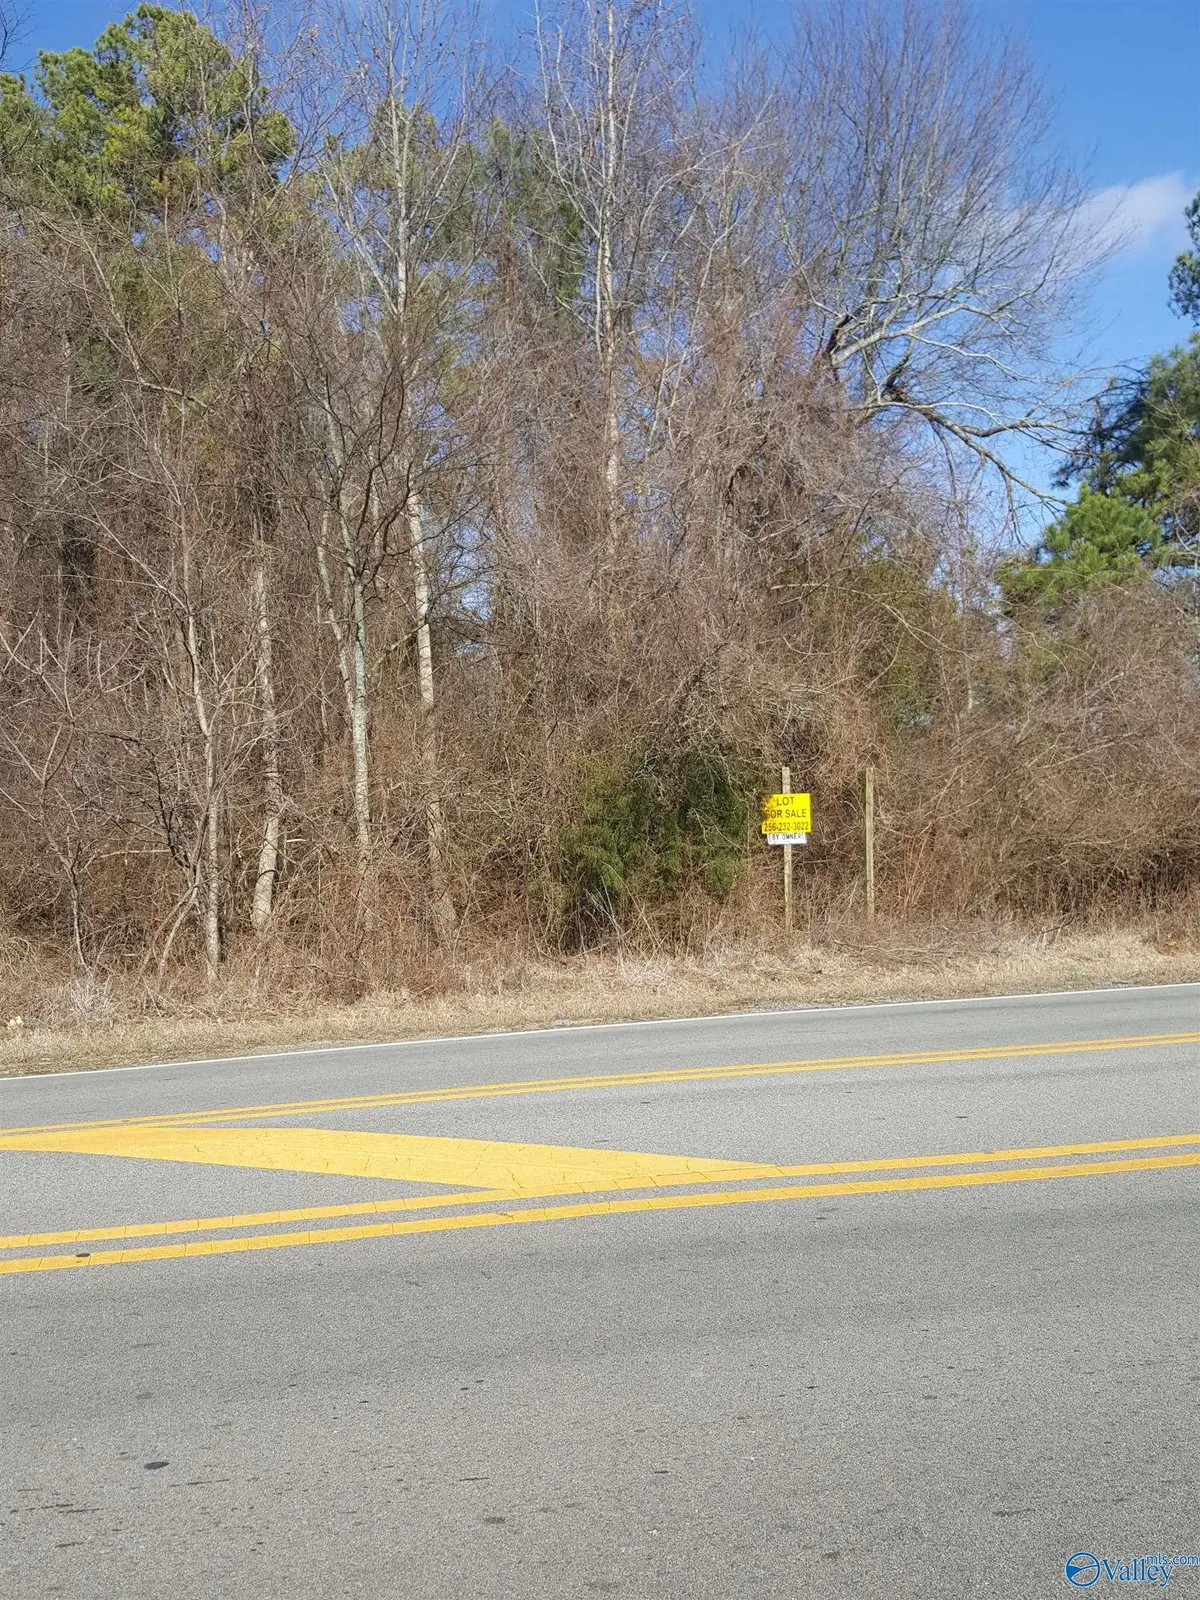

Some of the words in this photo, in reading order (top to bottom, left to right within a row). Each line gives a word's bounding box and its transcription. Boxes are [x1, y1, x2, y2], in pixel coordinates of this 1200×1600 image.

[776, 796, 795, 806] LOT
[785, 808, 807, 818] SALE
[764, 821, 809, 832] 256-232-3022
